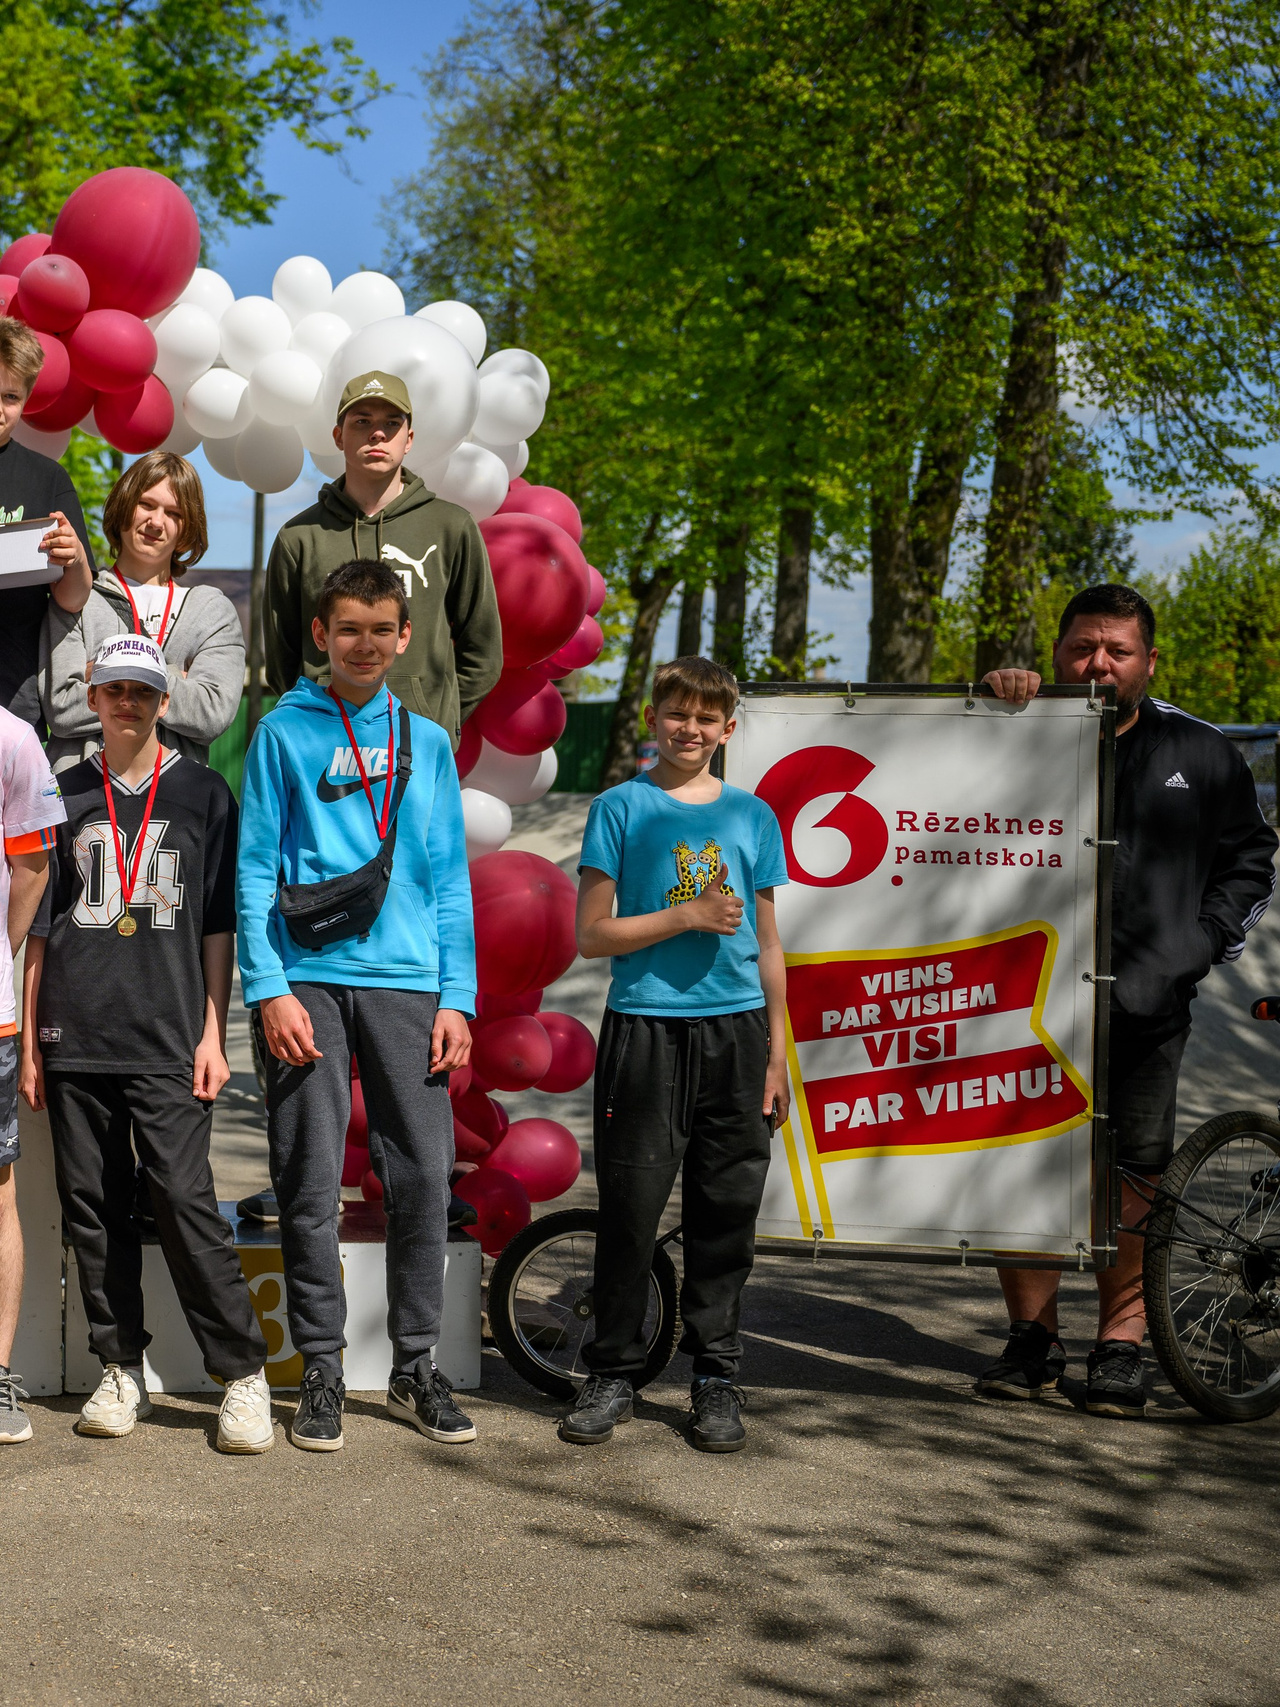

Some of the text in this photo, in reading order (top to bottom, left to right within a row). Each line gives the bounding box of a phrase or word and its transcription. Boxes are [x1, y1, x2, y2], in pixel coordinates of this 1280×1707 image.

[100, 640, 162, 667] COPENHAGEN
[328, 746, 389, 777] NIKE
[1164, 781, 1190, 789] adidas
[895, 810, 1065, 836] Rēzeknes
[894, 846, 1063, 868] pamatskola
[71, 820, 184, 930] 04
[861, 962, 954, 997] VIENS
[822, 983, 997, 1033] PAR VISIEM
[862, 1022, 958, 1069] VISI
[824, 1063, 1064, 1133] PAR VIENU!
